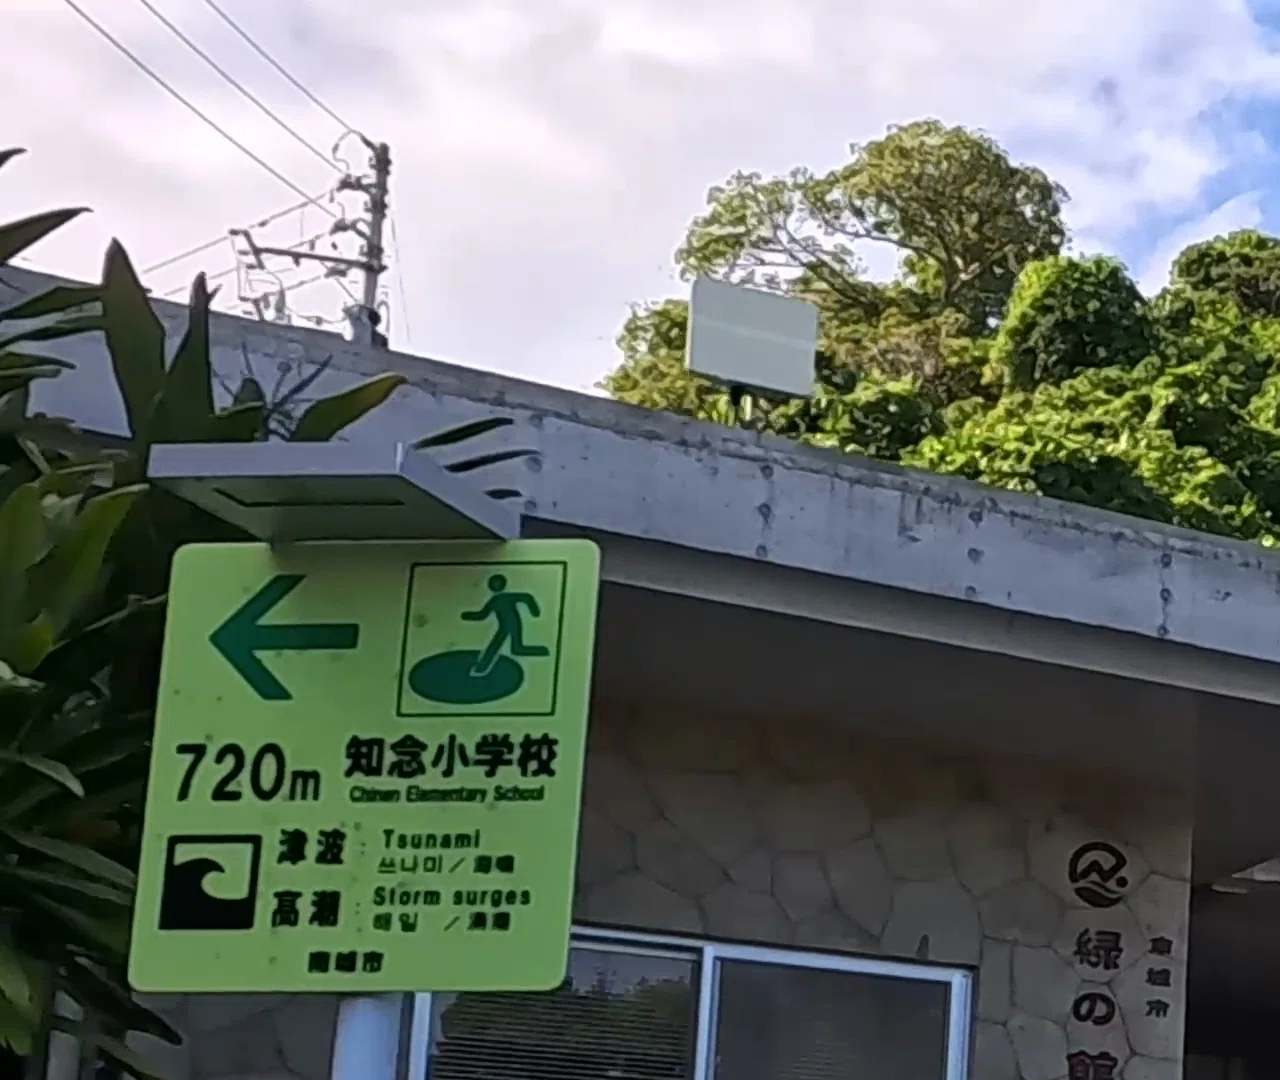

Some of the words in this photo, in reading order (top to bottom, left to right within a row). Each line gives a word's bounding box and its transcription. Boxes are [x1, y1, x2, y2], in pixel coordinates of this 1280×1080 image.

[344, 733, 559, 779] 知念小学校
[176, 743, 320, 802] 720m
[349, 784, 400, 802] Chinen
[406, 784, 487, 803] Elementary
[494, 784, 545, 802] School
[382, 829, 481, 849] Tsunami
[372, 886, 441, 906] Storm
[453, 889, 532, 907] surges
